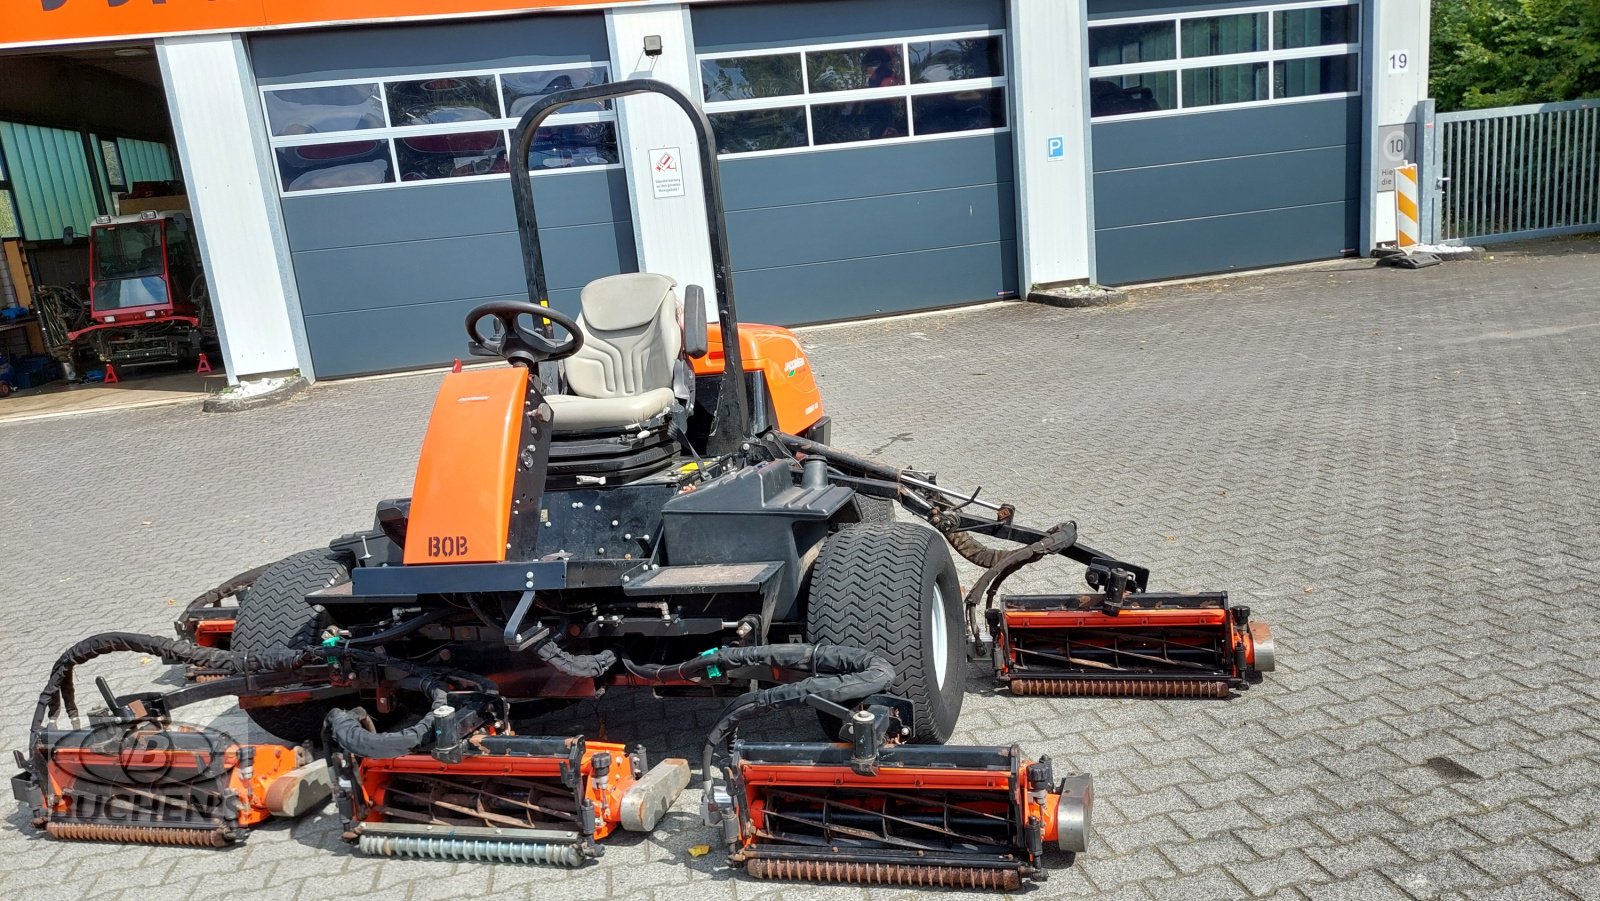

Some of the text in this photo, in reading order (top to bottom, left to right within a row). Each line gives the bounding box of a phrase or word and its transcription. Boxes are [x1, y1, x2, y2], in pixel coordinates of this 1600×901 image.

[1389, 53, 1407, 69] 19
[1050, 140, 1061, 155] P
[1390, 139, 1403, 153] 10
[1381, 178, 1392, 186] die
[428, 536, 468, 557] BOB
